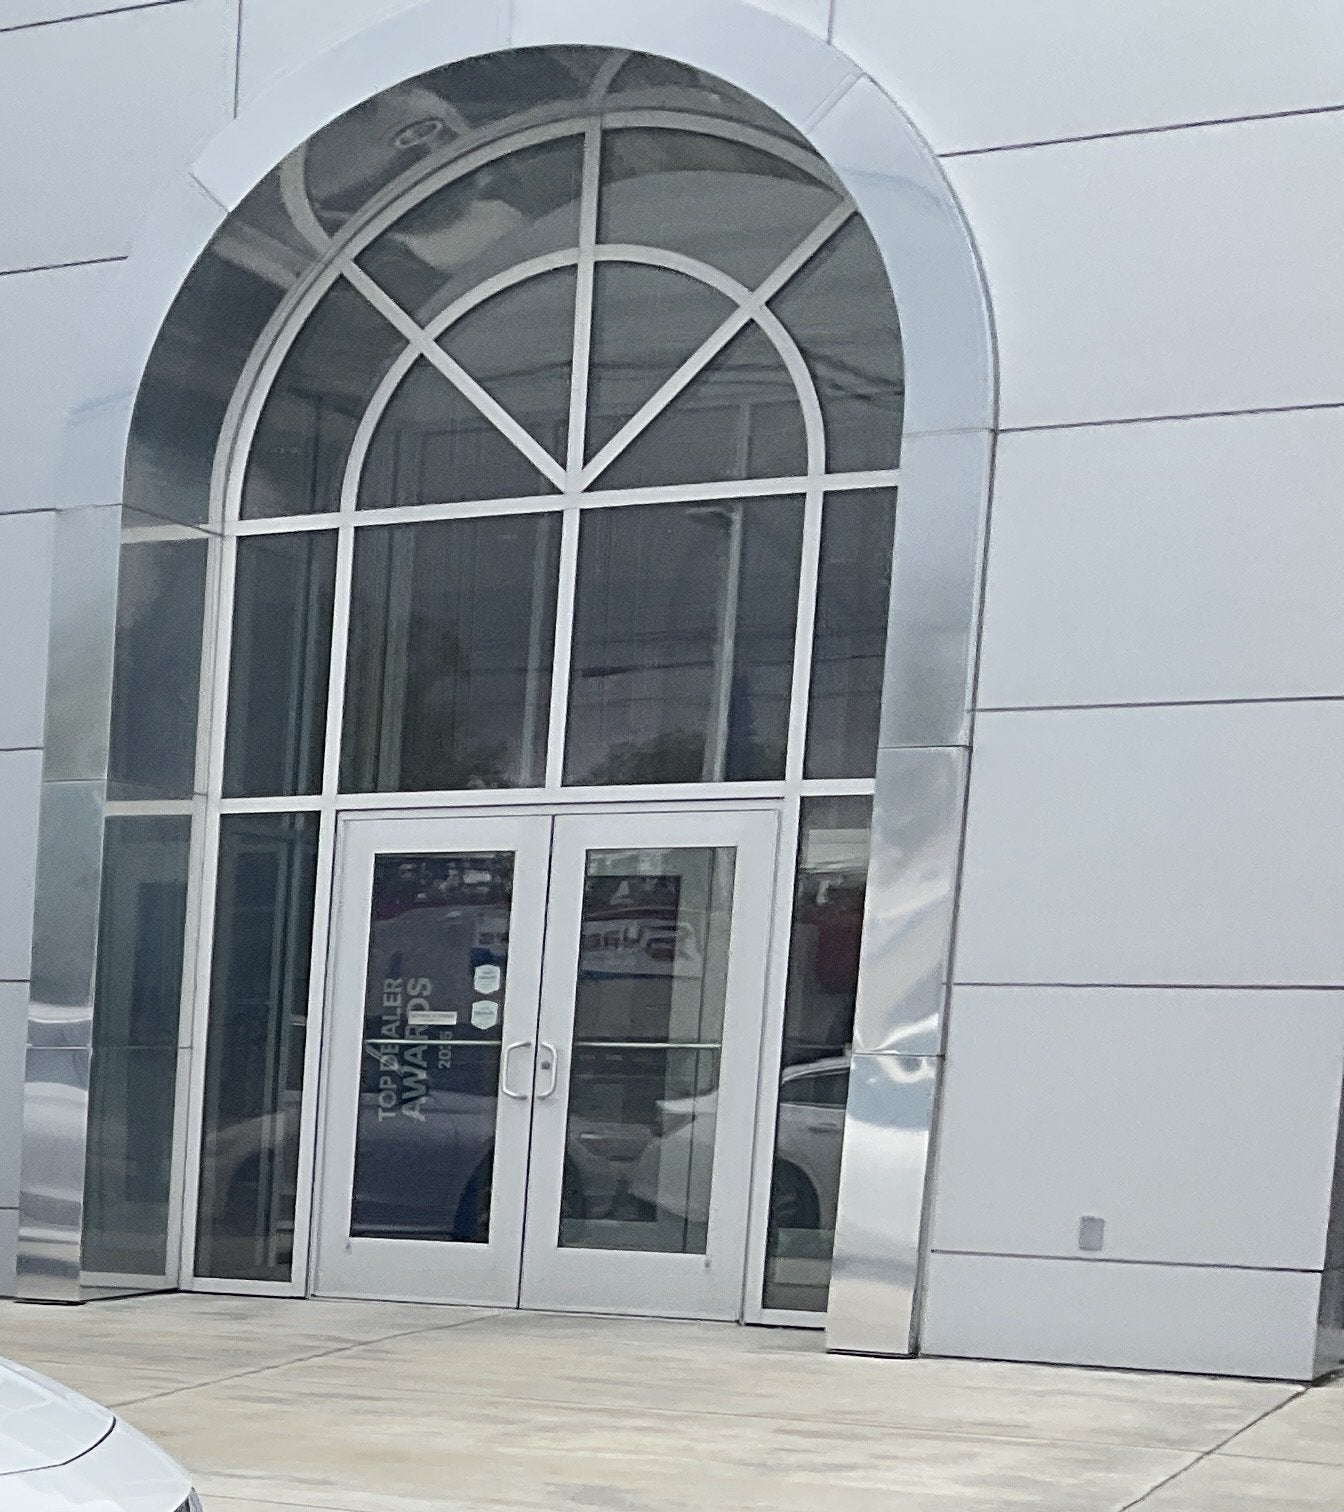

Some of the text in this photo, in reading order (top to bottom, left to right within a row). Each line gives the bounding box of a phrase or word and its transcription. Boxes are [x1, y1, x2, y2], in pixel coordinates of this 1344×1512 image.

[378, 978, 403, 1122] TOP DEALER
[401, 977, 433, 1122] AWARDS
